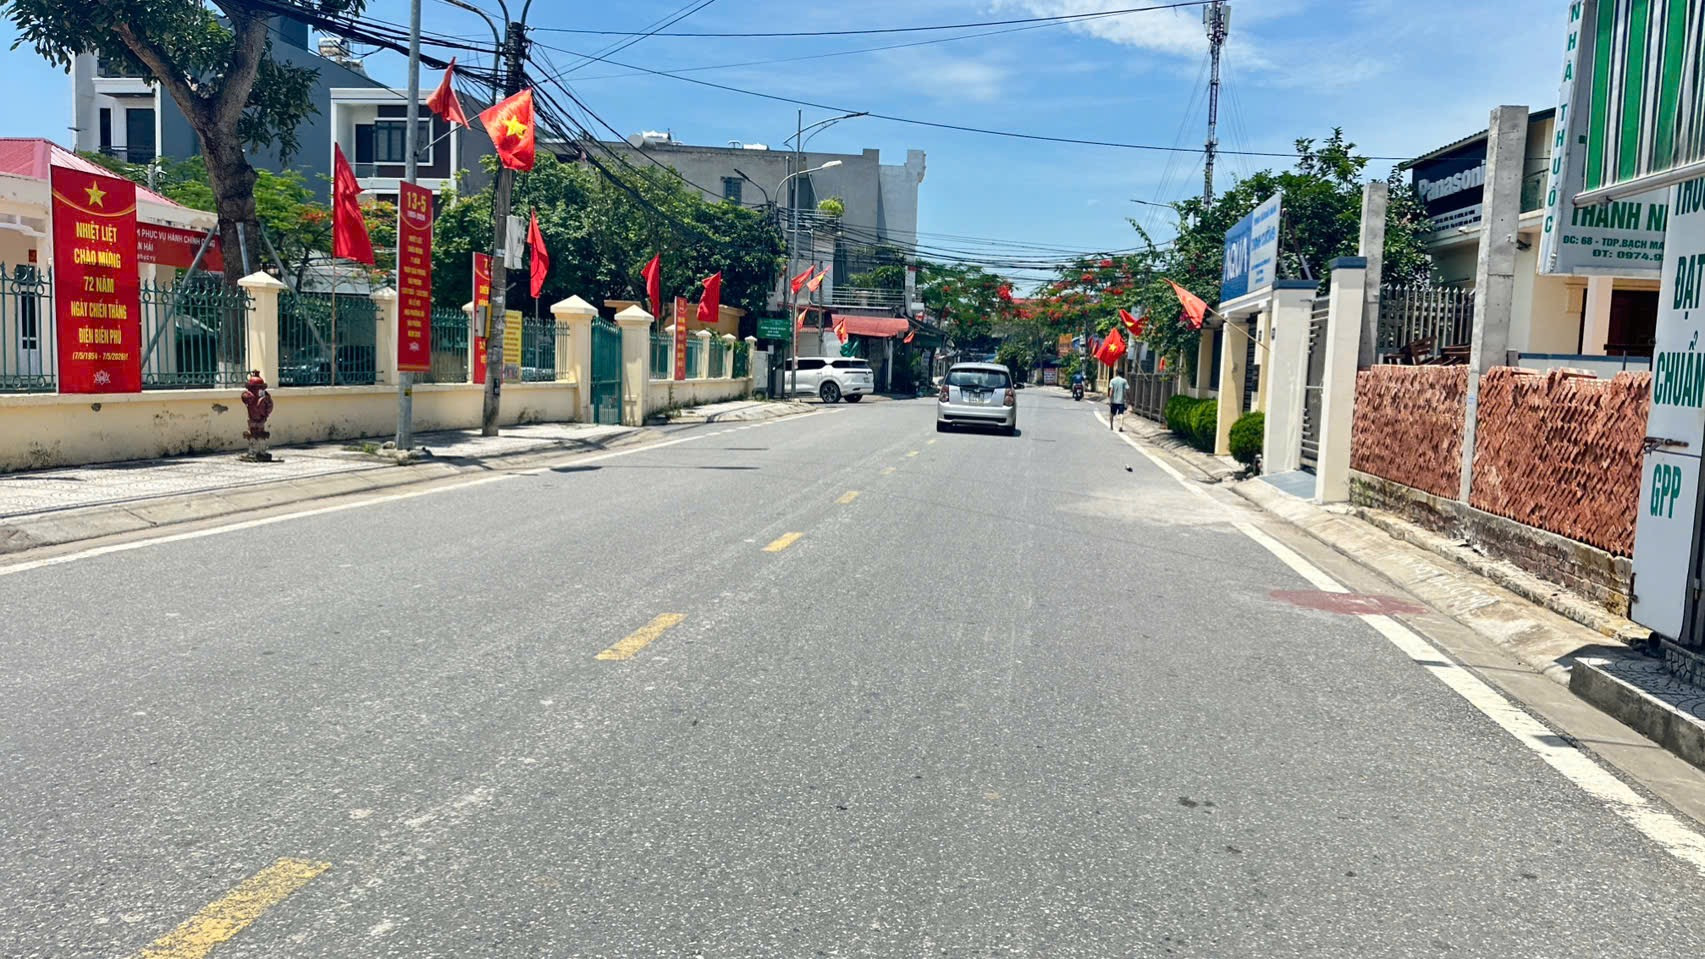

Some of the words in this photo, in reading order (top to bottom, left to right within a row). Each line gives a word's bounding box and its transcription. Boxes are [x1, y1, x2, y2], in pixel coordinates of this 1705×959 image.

[1563, 1, 1581, 82] NHÀ
[1544, 104, 1568, 233] THUỐC
[406, 191, 427, 213] 13-5
[76, 220, 100, 243] NHIỆT
[101, 223, 118, 246] LIỆT
[1580, 236, 1593, 246] 68
[74, 246, 97, 266] CHÀO
[1592, 249, 1613, 259] ĐT:
[1616, 251, 1664, 262] 0974.9
[83, 276, 95, 292] 72
[95, 275, 115, 294] NĂM
[70, 298, 88, 318] NGÀY
[88, 298, 108, 319] CHIẾN
[78, 325, 94, 348] ĐIỆN
[1650, 463, 1682, 519] GPP
